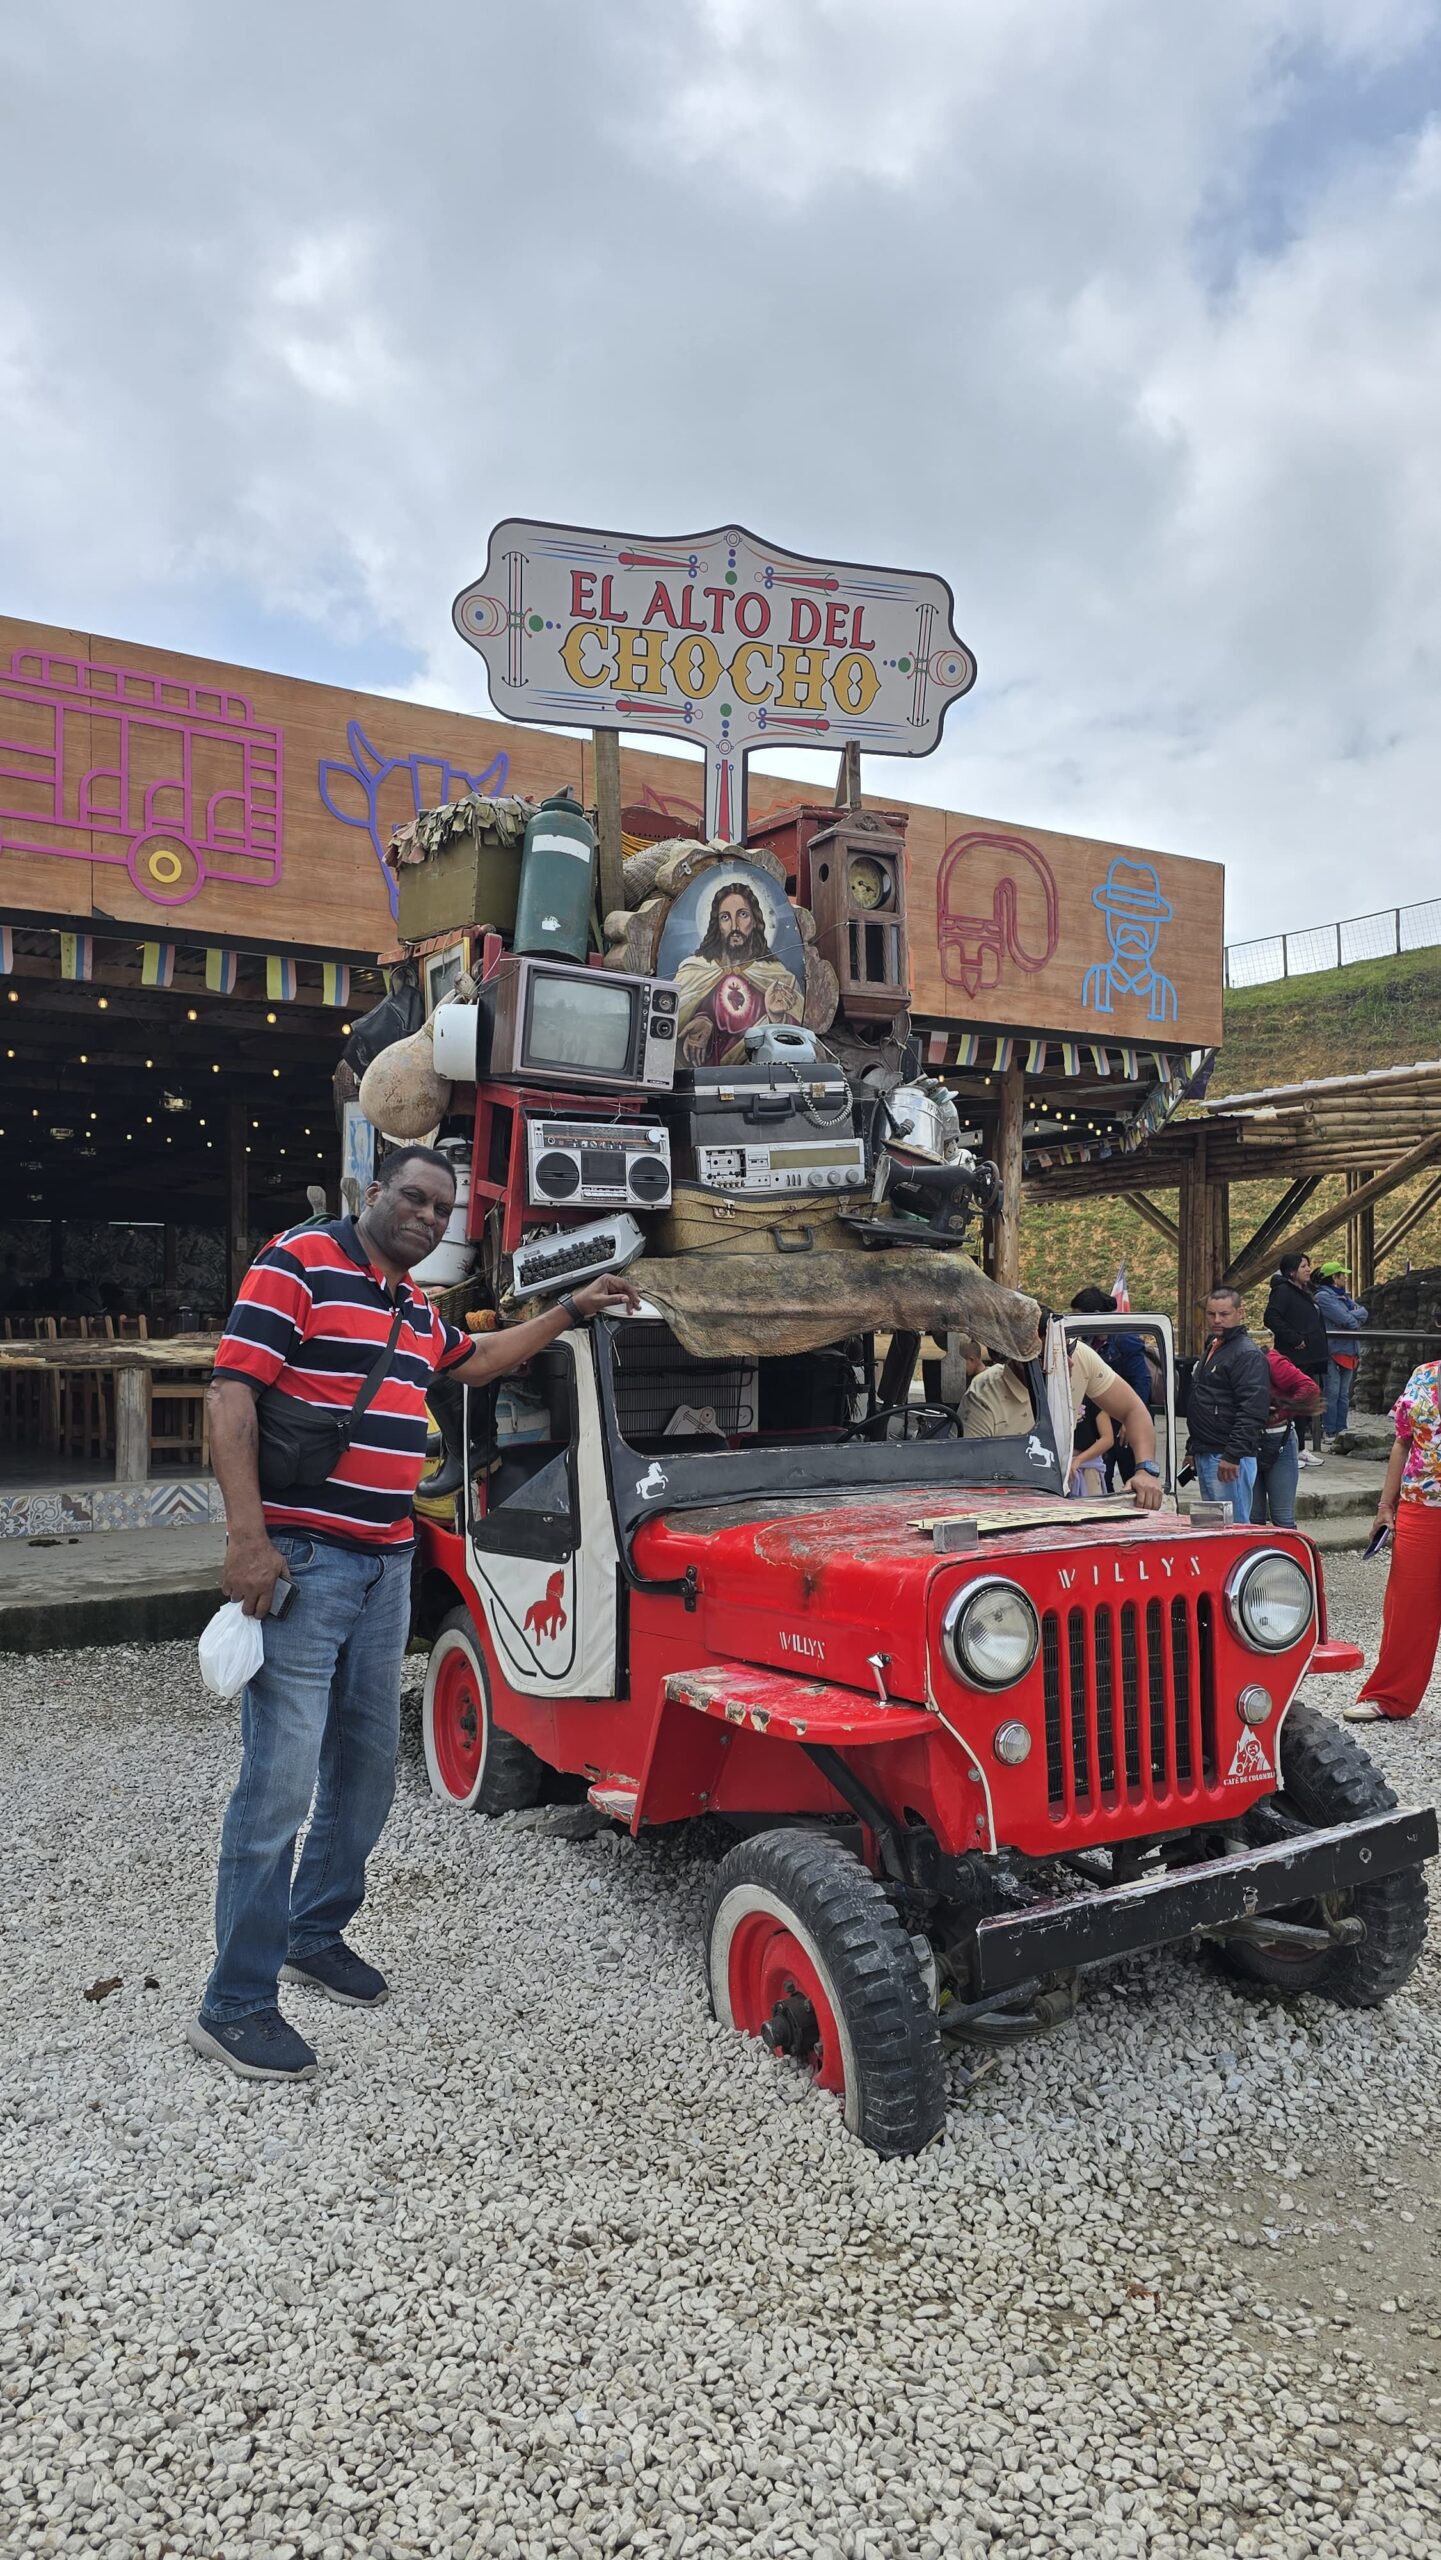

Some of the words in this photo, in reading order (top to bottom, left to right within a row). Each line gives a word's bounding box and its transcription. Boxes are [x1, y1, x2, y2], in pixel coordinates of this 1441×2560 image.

[570, 569, 628, 624] EL
[642, 580, 771, 639] ALTO
[789, 597, 876, 651] DEL
[558, 621, 882, 716] CHOCHO
[1057, 1555, 1201, 1590] WILLYS
[778, 1631, 826, 1661] WILLYS
[1239, 1775, 1249, 1784] DE
